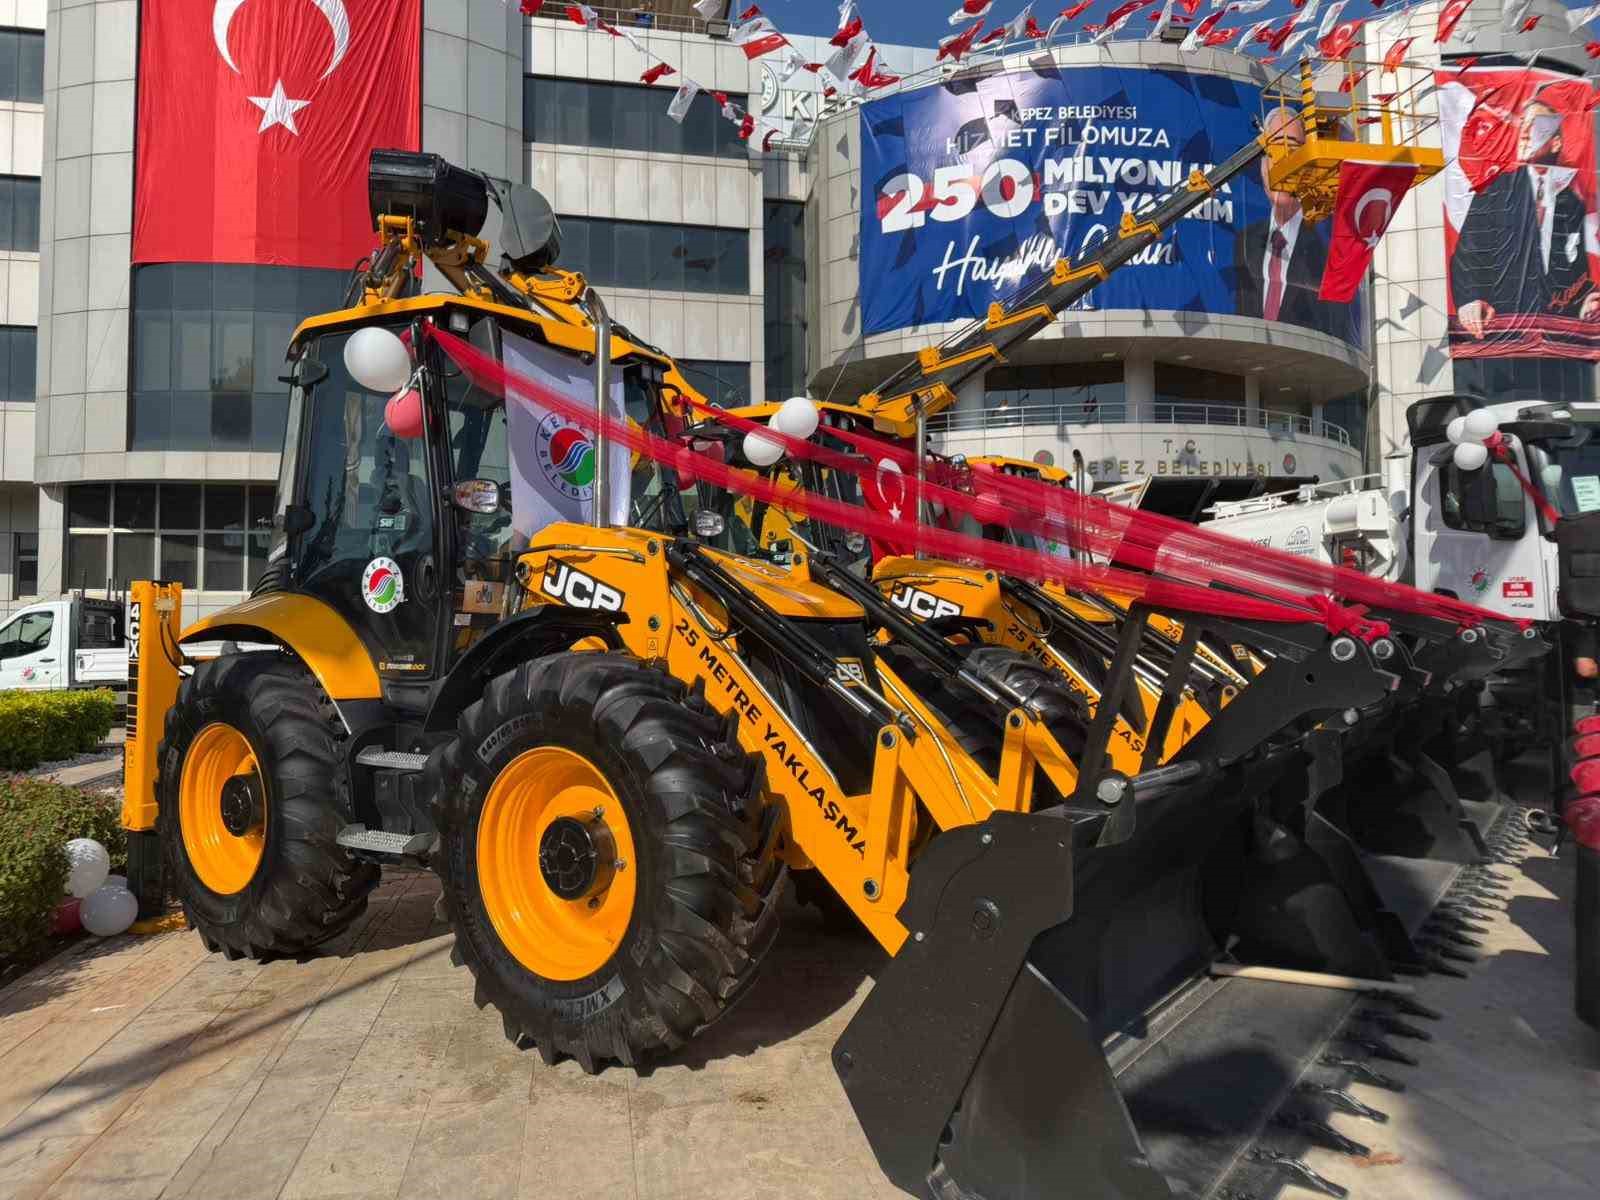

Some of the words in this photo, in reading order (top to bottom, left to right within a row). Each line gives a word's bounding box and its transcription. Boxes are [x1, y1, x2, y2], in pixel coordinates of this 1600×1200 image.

[1044, 123, 1171, 149] FİLOMUZA
[879, 158, 1034, 234] 250
[1044, 190, 1110, 217] DEV
[1072, 459, 1145, 475] EPEZ
[129, 603, 140, 658] 4CX
[1007, 623, 1028, 642] 25
[1164, 625, 1180, 640] 25
[676, 618, 700, 647] 25
[699, 646, 762, 725] METRE
